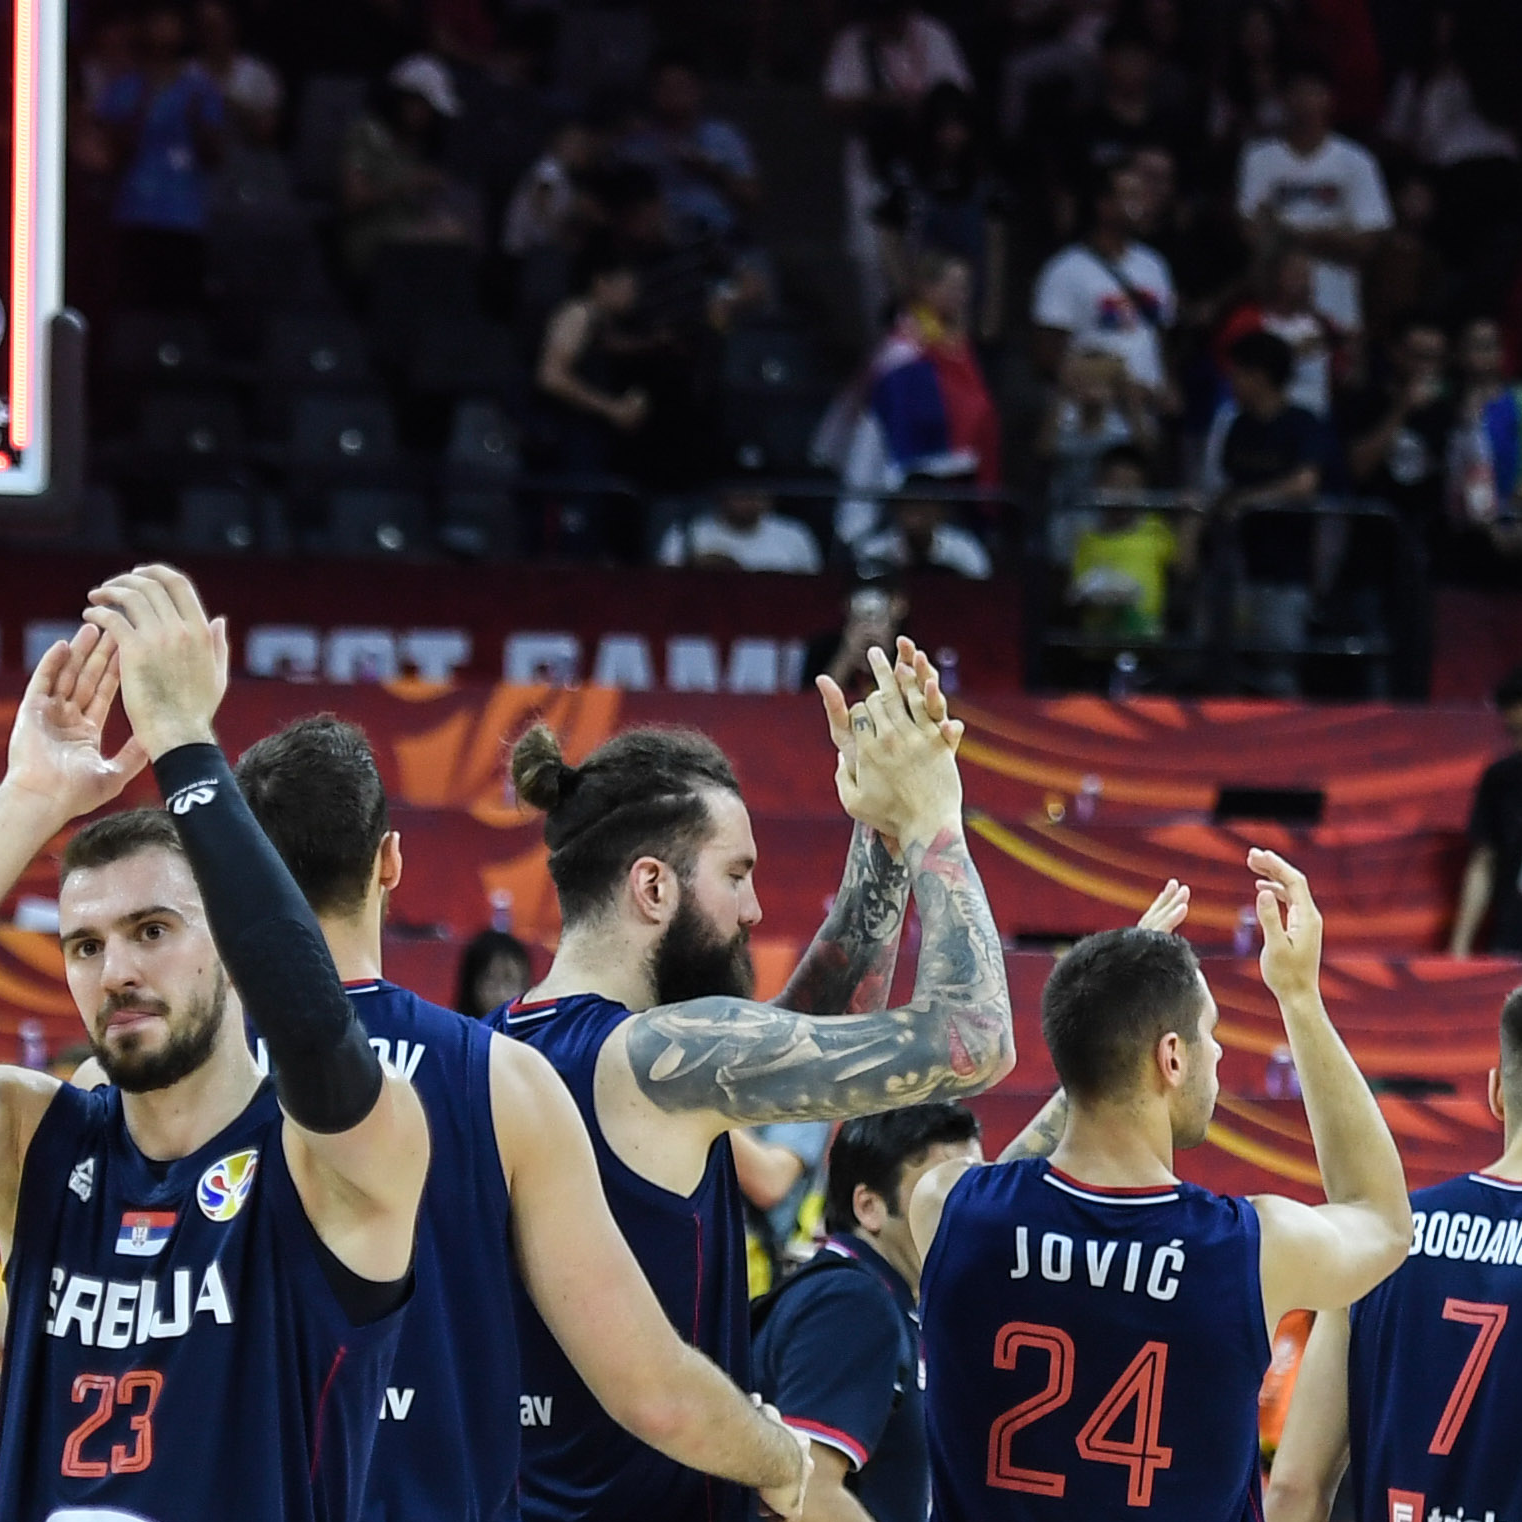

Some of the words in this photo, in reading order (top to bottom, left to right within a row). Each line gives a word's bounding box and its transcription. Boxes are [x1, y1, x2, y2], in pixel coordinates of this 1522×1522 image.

[1010, 1225, 1186, 1301] JOVIĆ
[60, 1369, 165, 1478] 23
[985, 1320, 1174, 1508] 24
[1427, 1297, 1510, 1456] 7
